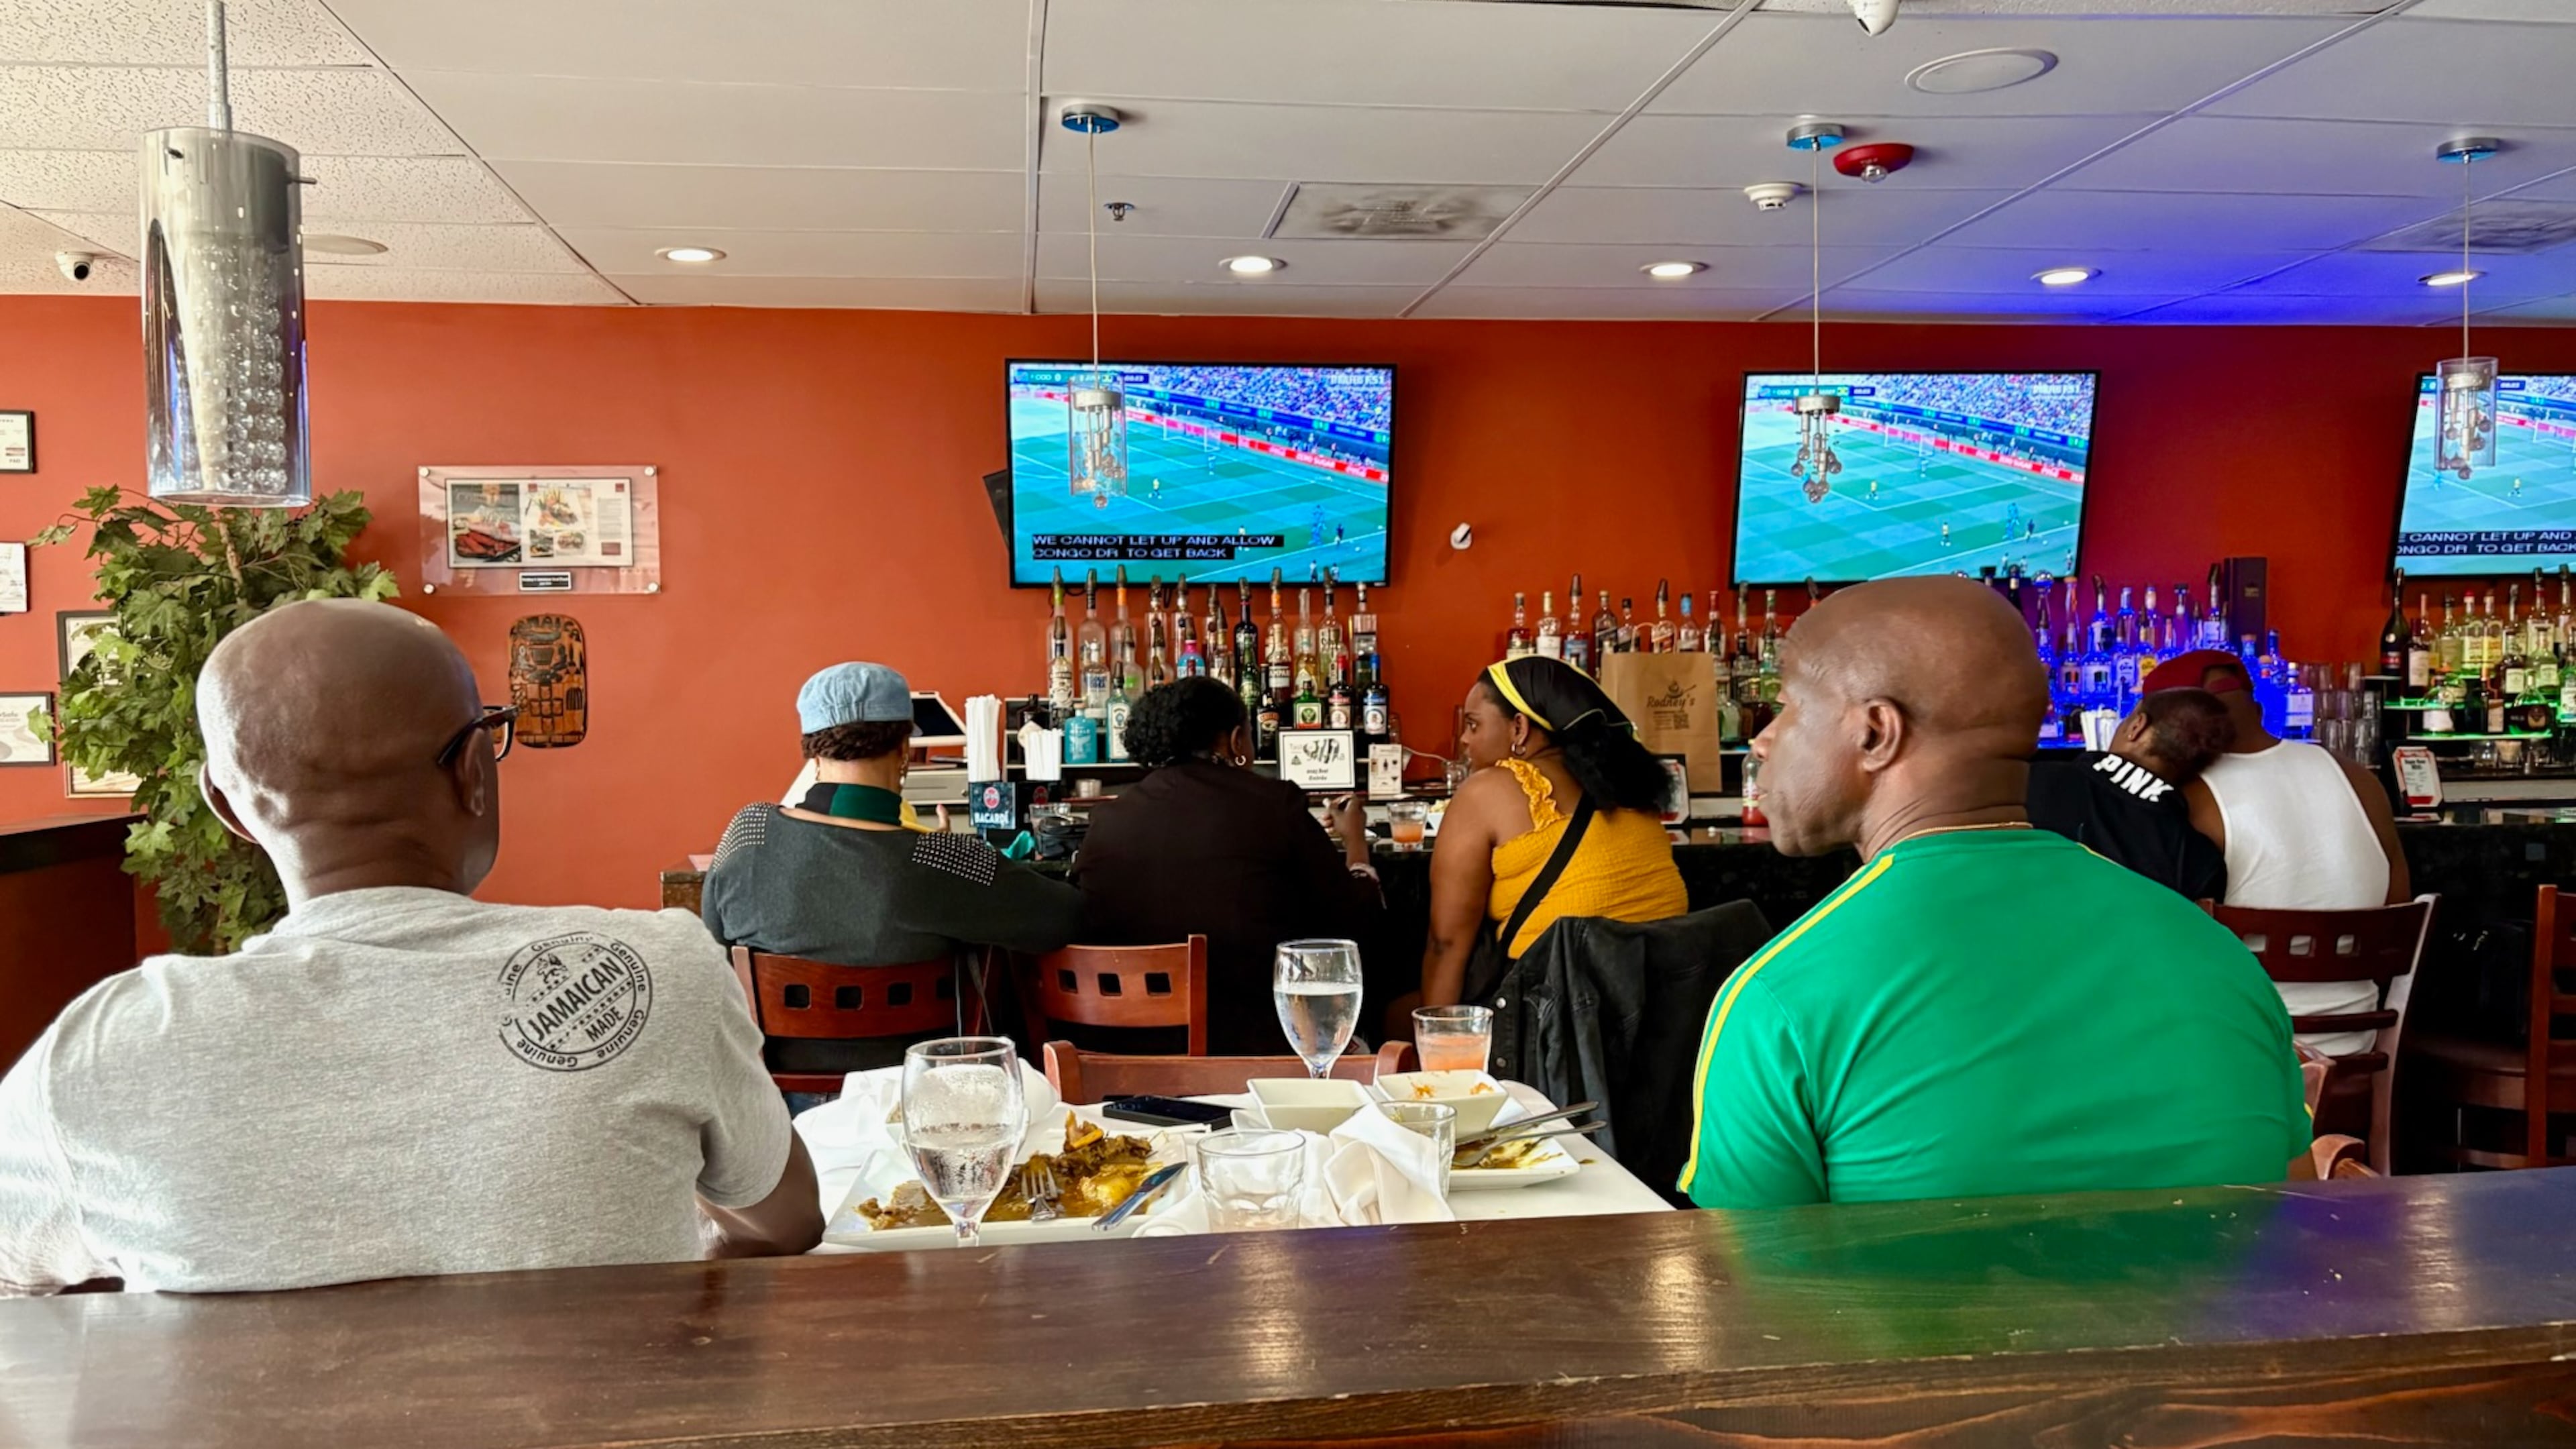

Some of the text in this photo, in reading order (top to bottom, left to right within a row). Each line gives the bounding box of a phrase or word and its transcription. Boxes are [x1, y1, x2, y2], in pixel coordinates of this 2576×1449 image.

[1033, 536, 1275, 545] WE CANNOT LET UP AND ALLOW
[2410, 533, 2477, 543] CANNOT
[2481, 532, 2508, 541] LET
[2514, 531, 2536, 541] UP
[2538, 531, 2572, 541] AND
[2475, 543, 2499, 553] TO
[2500, 543, 2534, 553] GET
[2537, 542, 2576, 552] BACK
[1033, 548, 1091, 558] CONGO
[1126, 548, 1148, 558] TO
[1150, 548, 1180, 558] GET
[1186, 548, 1226, 558] BACK
[1646, 694, 1696, 709] Rodney's
[2092, 753, 2174, 802] PINK
[610, 942, 647, 993] Genuine
[527, 957, 625, 1041] JAMAICAN
[585, 1006, 625, 1042] MADE
[597, 1009, 645, 1059] Genuine
[517, 1038, 578, 1067] Genuine
